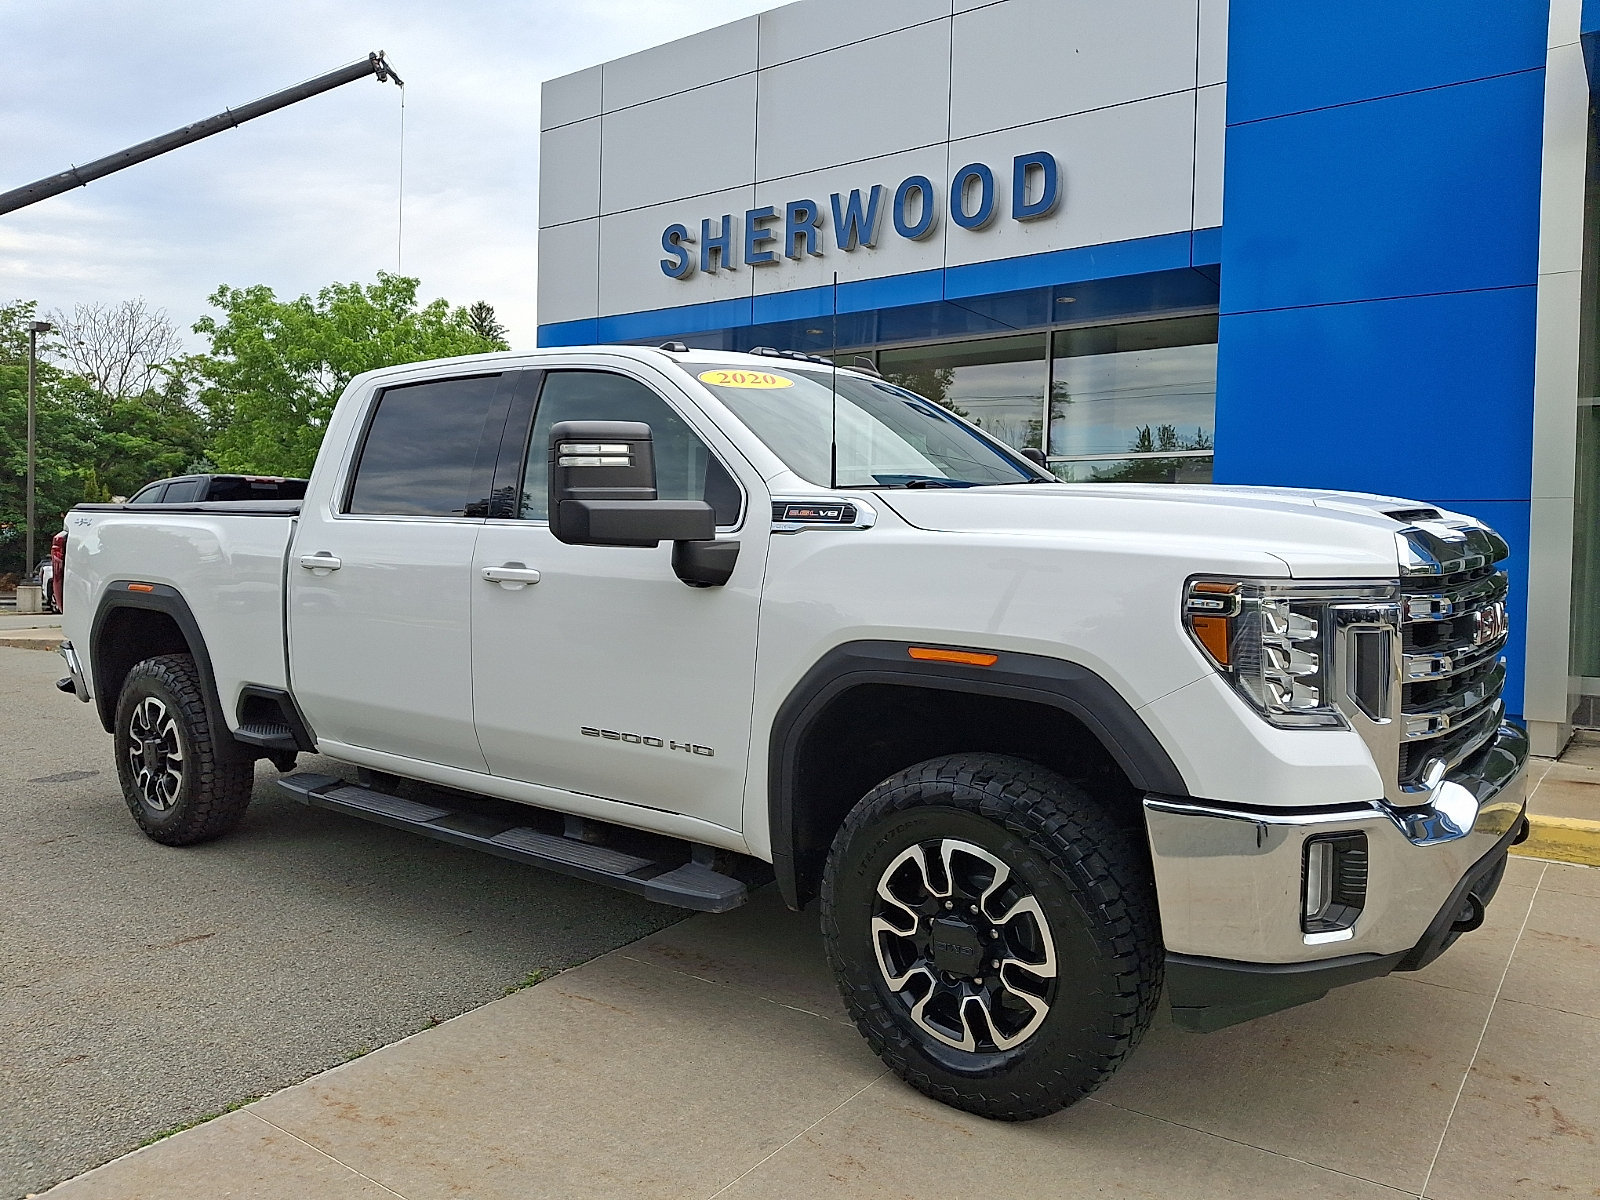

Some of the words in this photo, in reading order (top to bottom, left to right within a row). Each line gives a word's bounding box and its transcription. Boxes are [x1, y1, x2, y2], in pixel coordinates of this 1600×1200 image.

[660, 150, 1061, 280] SHERWOOD
[716, 372, 777, 385] 2020
[669, 740, 714, 757] HD
